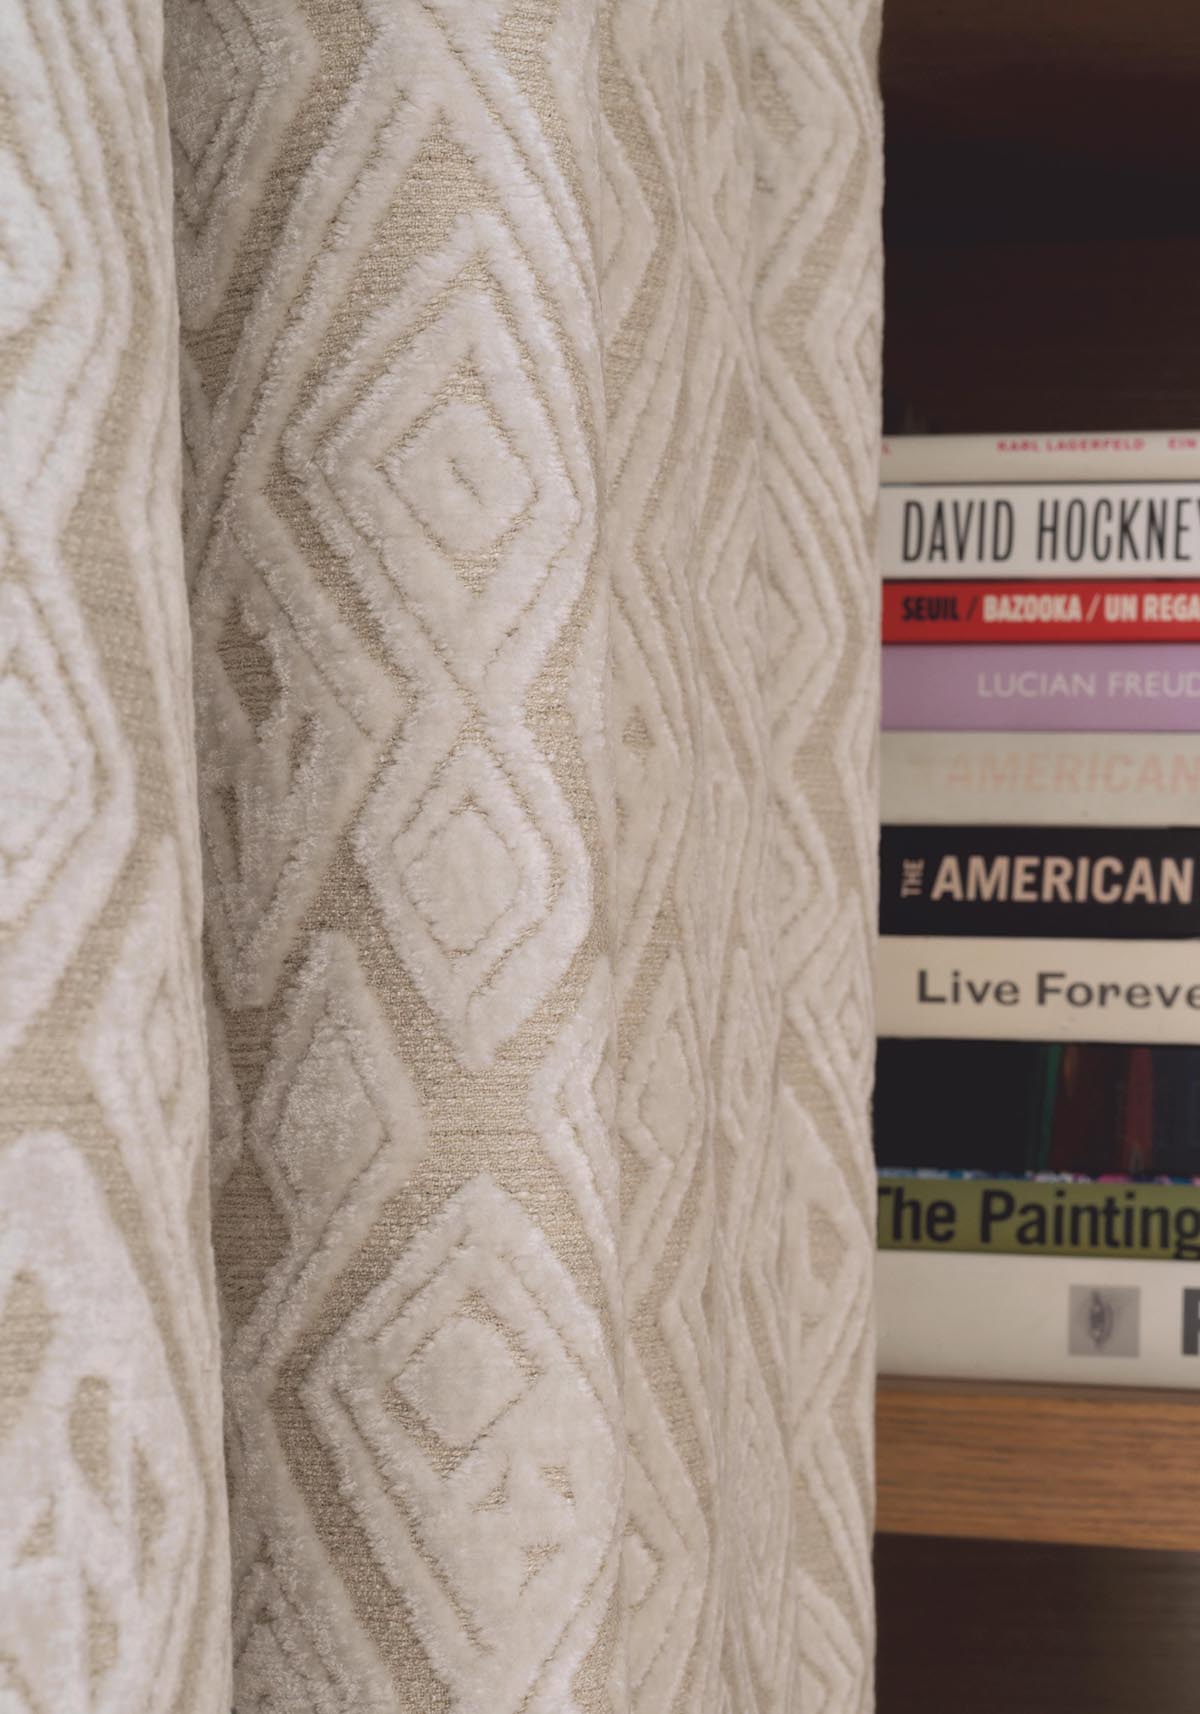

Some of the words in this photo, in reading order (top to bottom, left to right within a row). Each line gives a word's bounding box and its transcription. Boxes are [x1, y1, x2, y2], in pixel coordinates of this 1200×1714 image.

[996, 438, 1039, 452] KARL
[903, 500, 1014, 561] DAVID
[1036, 498, 1200, 562] HOCKNE
[903, 597, 959, 621] SEUIL
[983, 595, 1083, 622] BAZOOKA
[1104, 594, 1138, 621] UN
[978, 673, 1096, 698] LUCIAN
[946, 751, 1200, 794] AMERICAN
[902, 859, 925, 897] THE
[930, 855, 1194, 904] AMERICAN
[917, 970, 1020, 1006] Live
